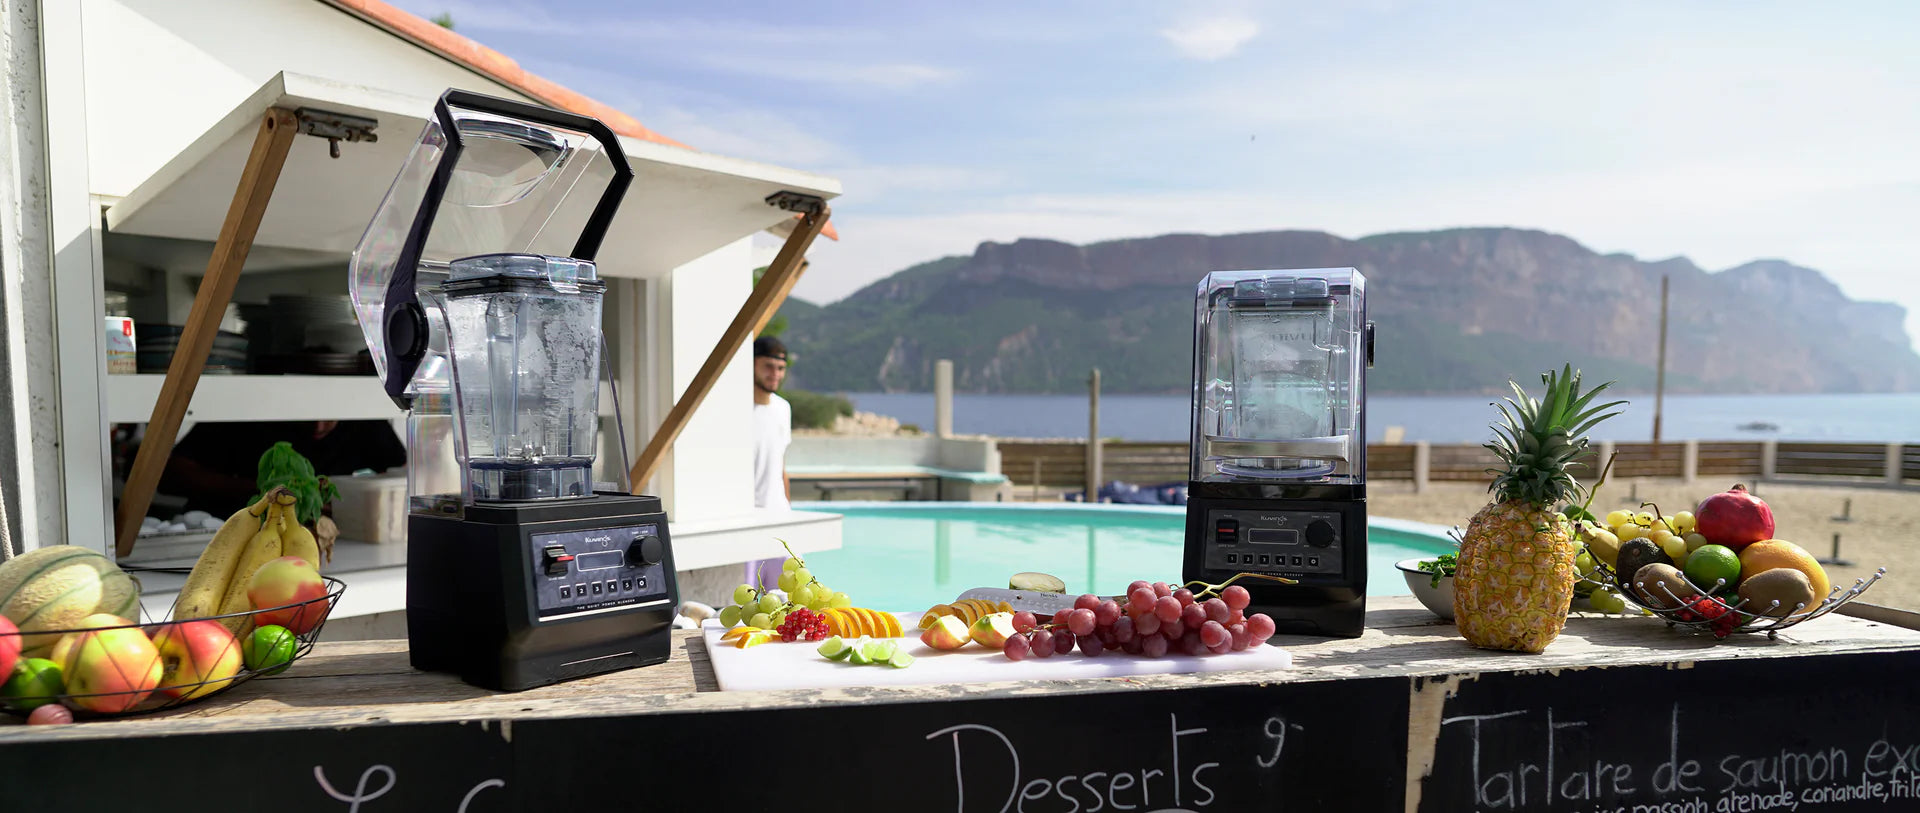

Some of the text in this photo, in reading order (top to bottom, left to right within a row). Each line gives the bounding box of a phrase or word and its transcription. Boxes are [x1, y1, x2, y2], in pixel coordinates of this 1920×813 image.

[1260, 514, 1288, 526] Kuvings
[584, 535, 611, 547] Kuvings
[926, 712, 1220, 813] Desserts
[1652, 701, 1705, 793] de
[1719, 748, 1848, 794] saumon
[1801, 771, 1889, 803] coriandre,
